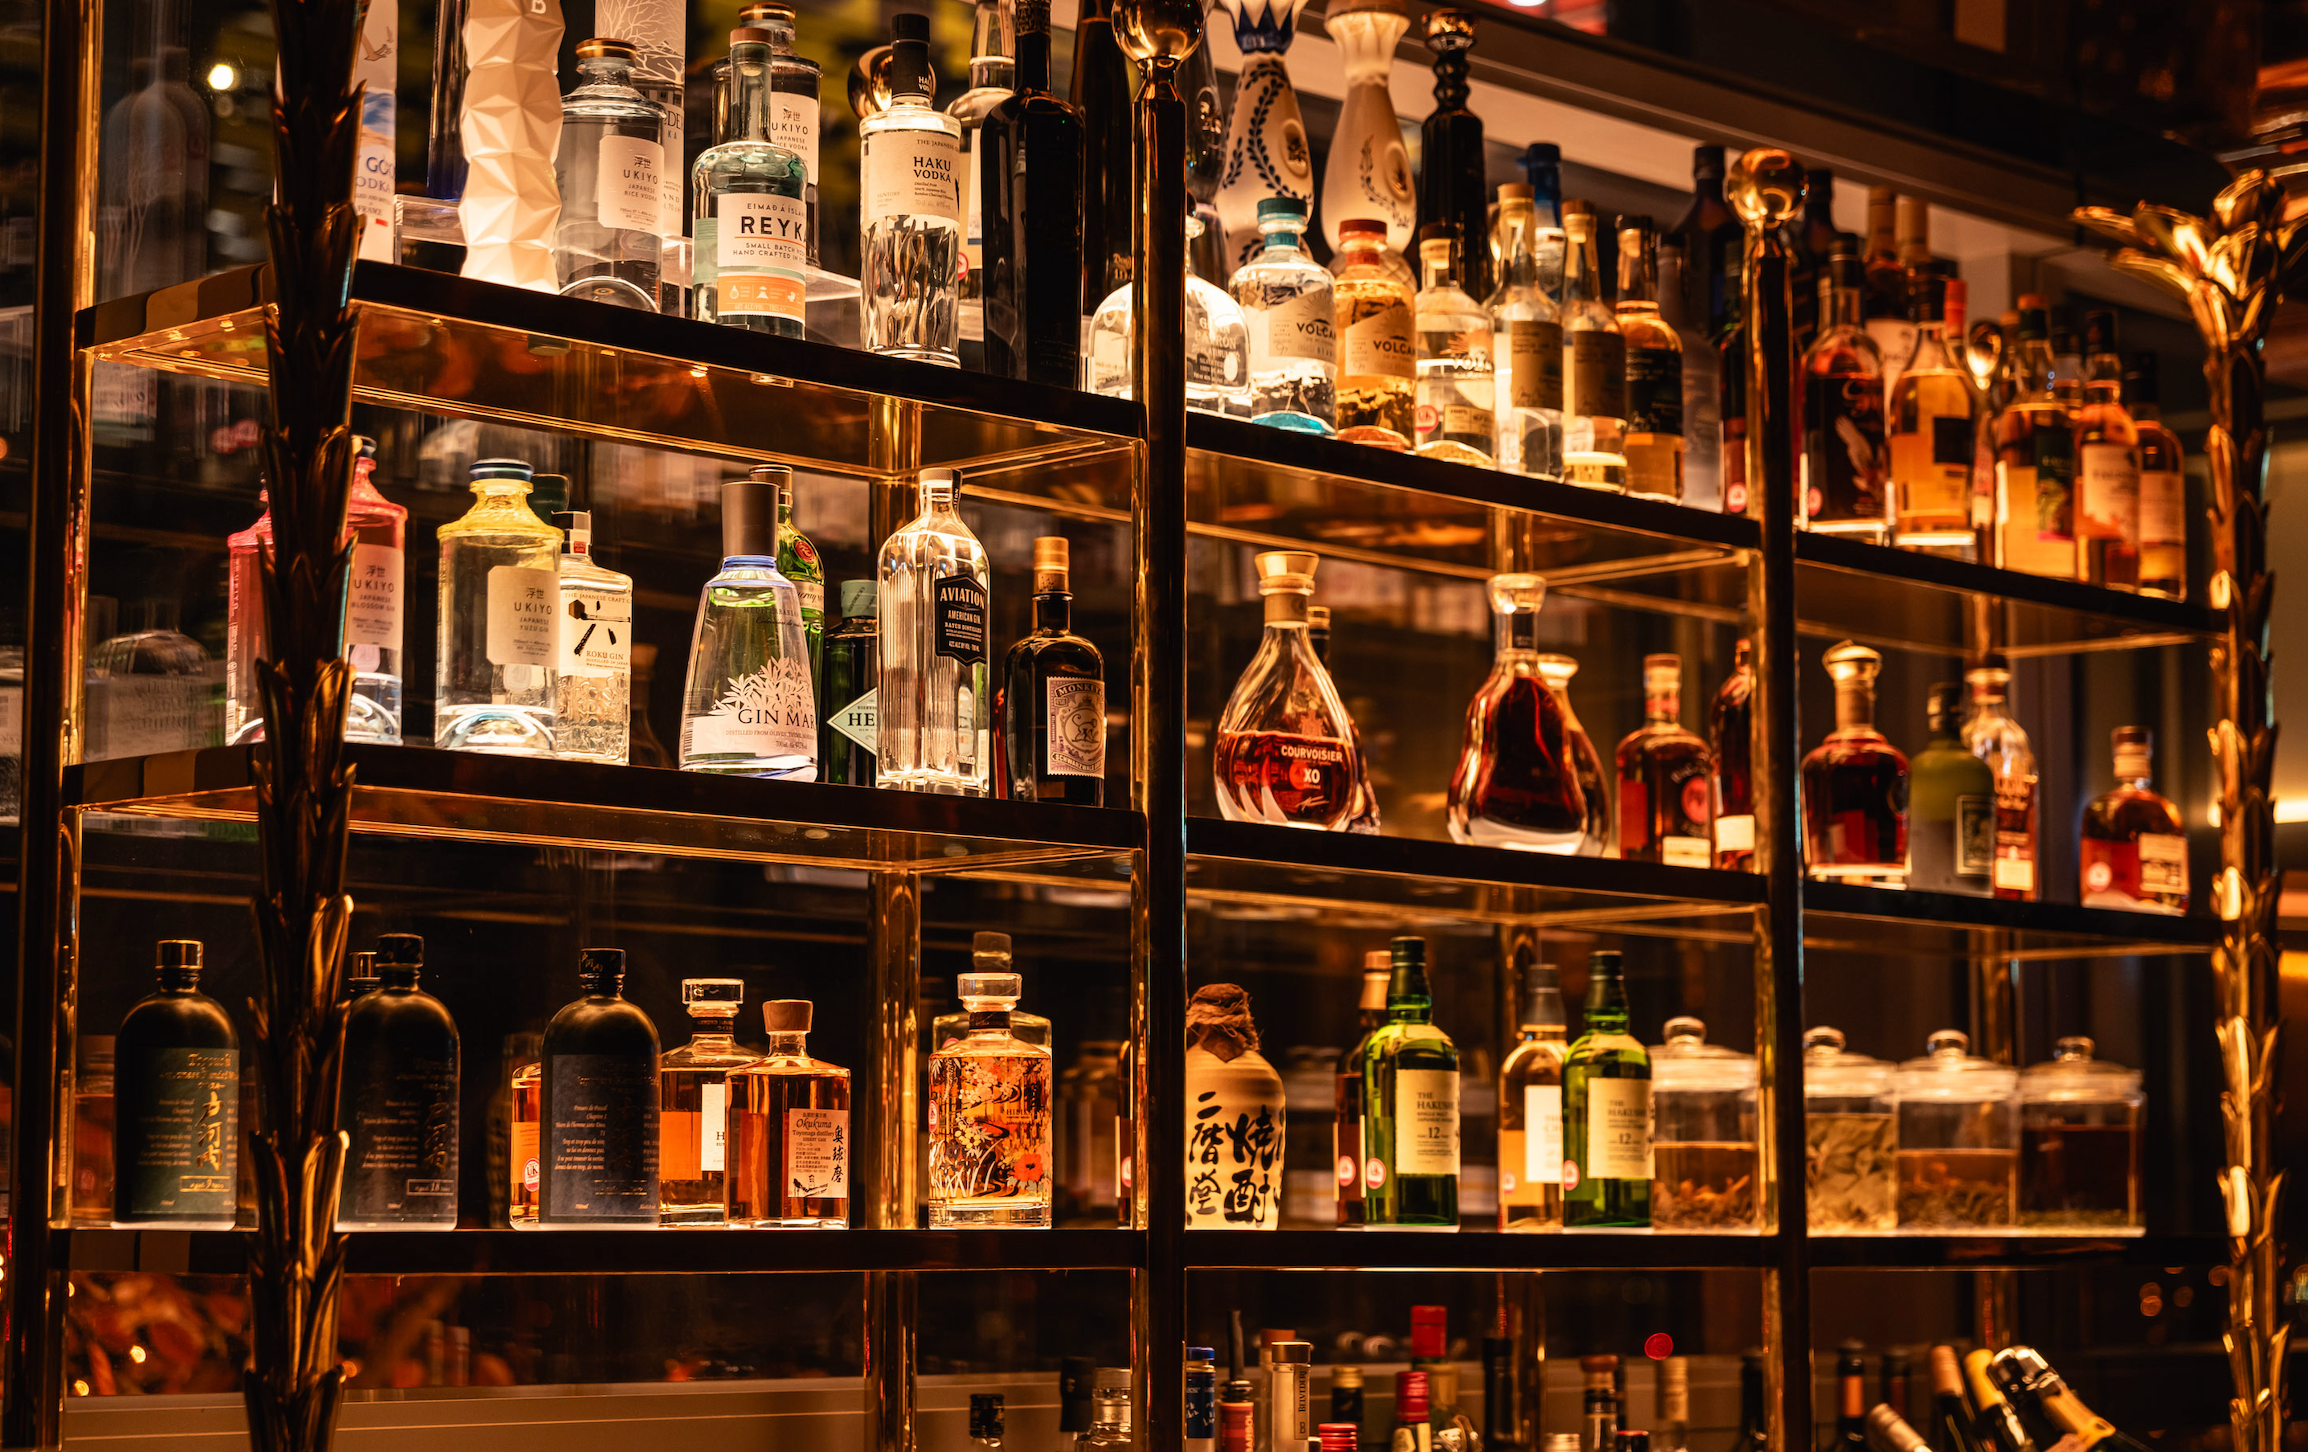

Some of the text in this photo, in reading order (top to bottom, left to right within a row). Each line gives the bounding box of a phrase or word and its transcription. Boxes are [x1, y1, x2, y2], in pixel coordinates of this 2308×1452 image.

[771, 122, 809, 135] UKIYO
[913, 156, 951, 172] HAKU
[623, 169, 659, 185] UKIYO
[913, 169, 952, 183] VODKA
[740, 216, 807, 243] REYK
[745, 242, 771, 250] SMALL
[758, 250, 791, 259] CRAFTED
[354, 579, 395, 593] UKIYO
[939, 587, 985, 610] AVIATION
[514, 602, 553, 615] UKIYO
[947, 609, 973, 623] AMERICAN
[586, 650, 624, 660] ROKU GIN
[738, 708, 816, 731] GIN MAR
[848, 712, 876, 727] HE
[1281, 744, 1343, 762] COURVOISIER
[1303, 768, 1321, 784] XO
[796, 1118, 832, 1131] Okukuma
[1428, 1126, 1440, 1139] 12
[1619, 1133, 1632, 1145] 12
[526, 1166, 538, 1176] UK
